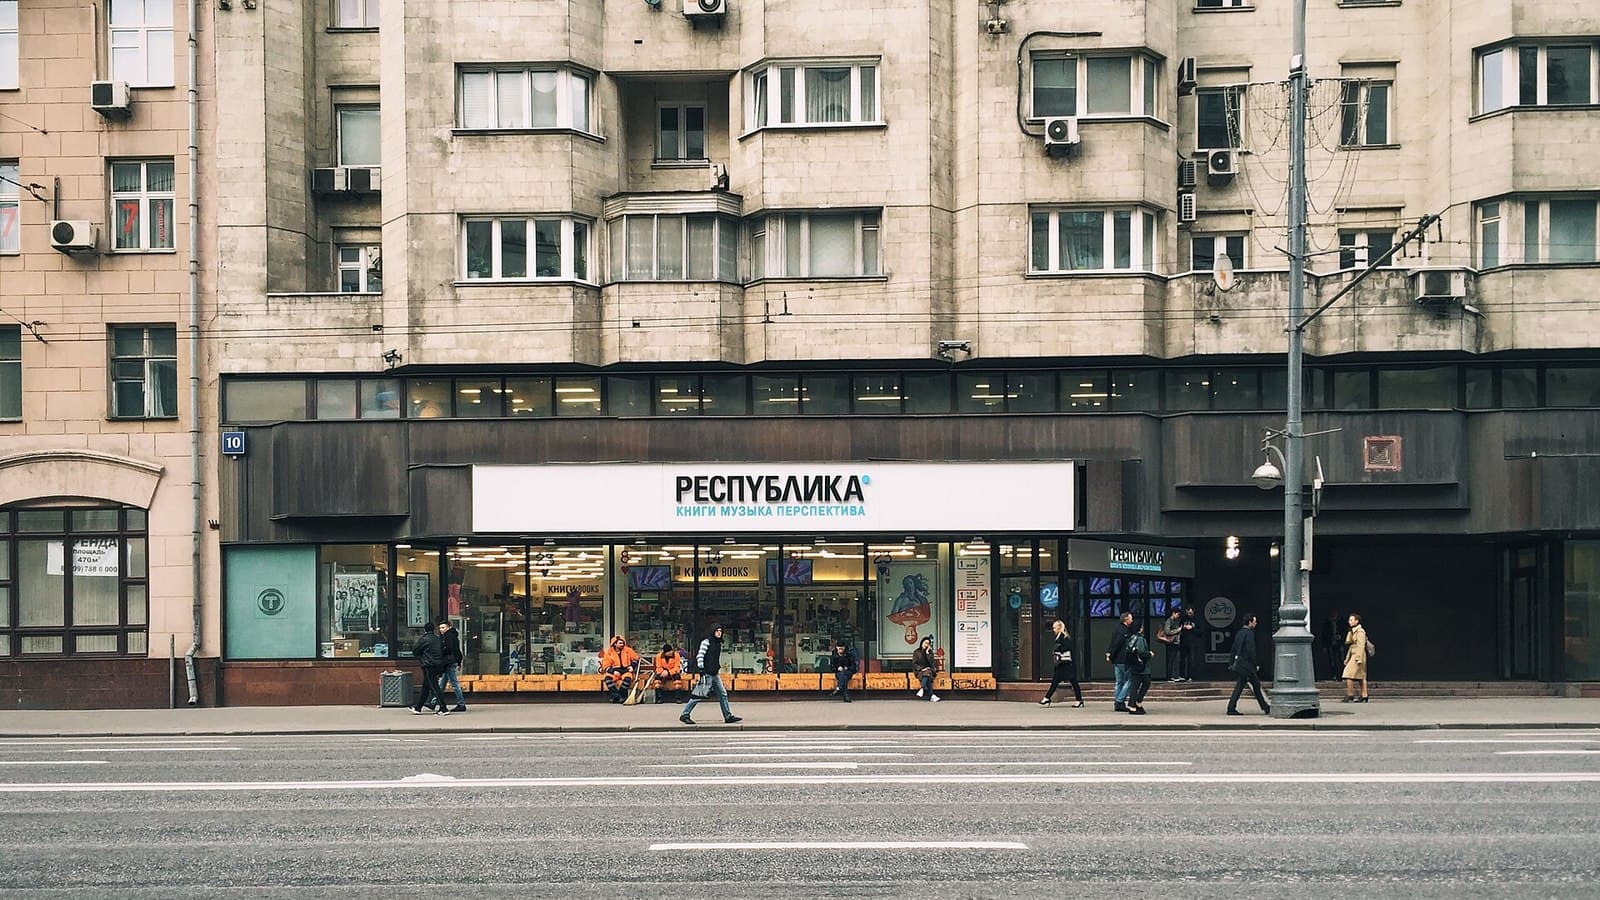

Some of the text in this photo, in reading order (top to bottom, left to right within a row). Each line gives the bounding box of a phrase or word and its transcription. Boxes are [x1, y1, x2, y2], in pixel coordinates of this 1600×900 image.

[120, 202, 138, 234] 7
[226, 436, 241, 449] 10
[675, 475, 865, 503] РЕСПУБЛИКА
[676, 505, 866, 517] КНИГИ МУЗЫКА ПЕРСПЕКТИВА
[721, 566, 749, 577] BOOKS
